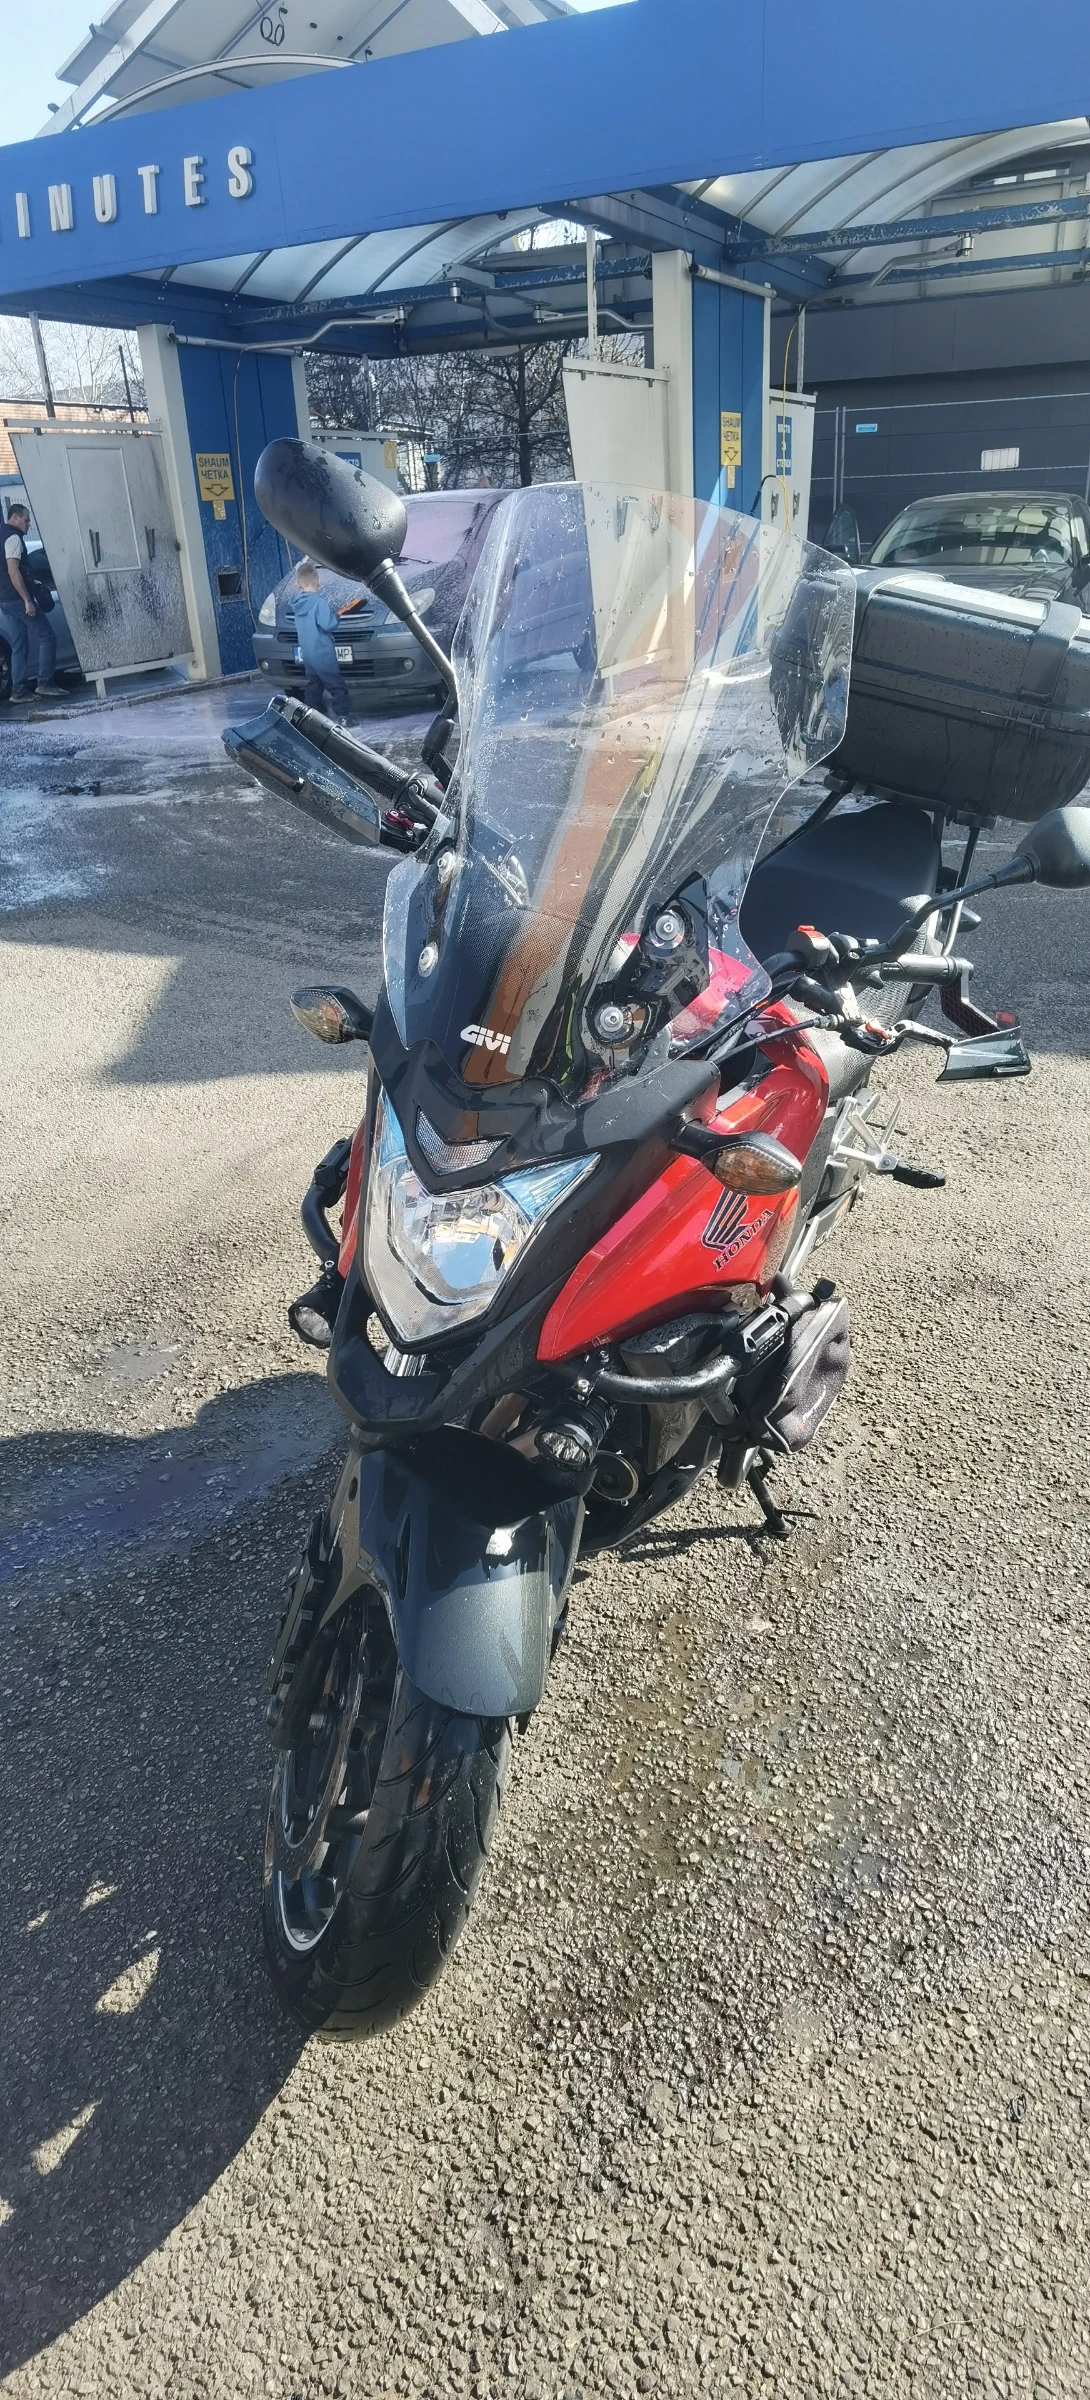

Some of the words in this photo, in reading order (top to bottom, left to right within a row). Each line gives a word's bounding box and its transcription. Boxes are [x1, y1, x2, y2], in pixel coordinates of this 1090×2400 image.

[14, 145, 253, 239] INUTES
[723, 430, 740, 442] ЧЕТКА
[198, 457, 230, 468] SHAUM
[201, 469, 229, 480] ЧЕТКА
[460, 1024, 512, 1055] GIVI
[712, 1208, 775, 1273] HONDA
